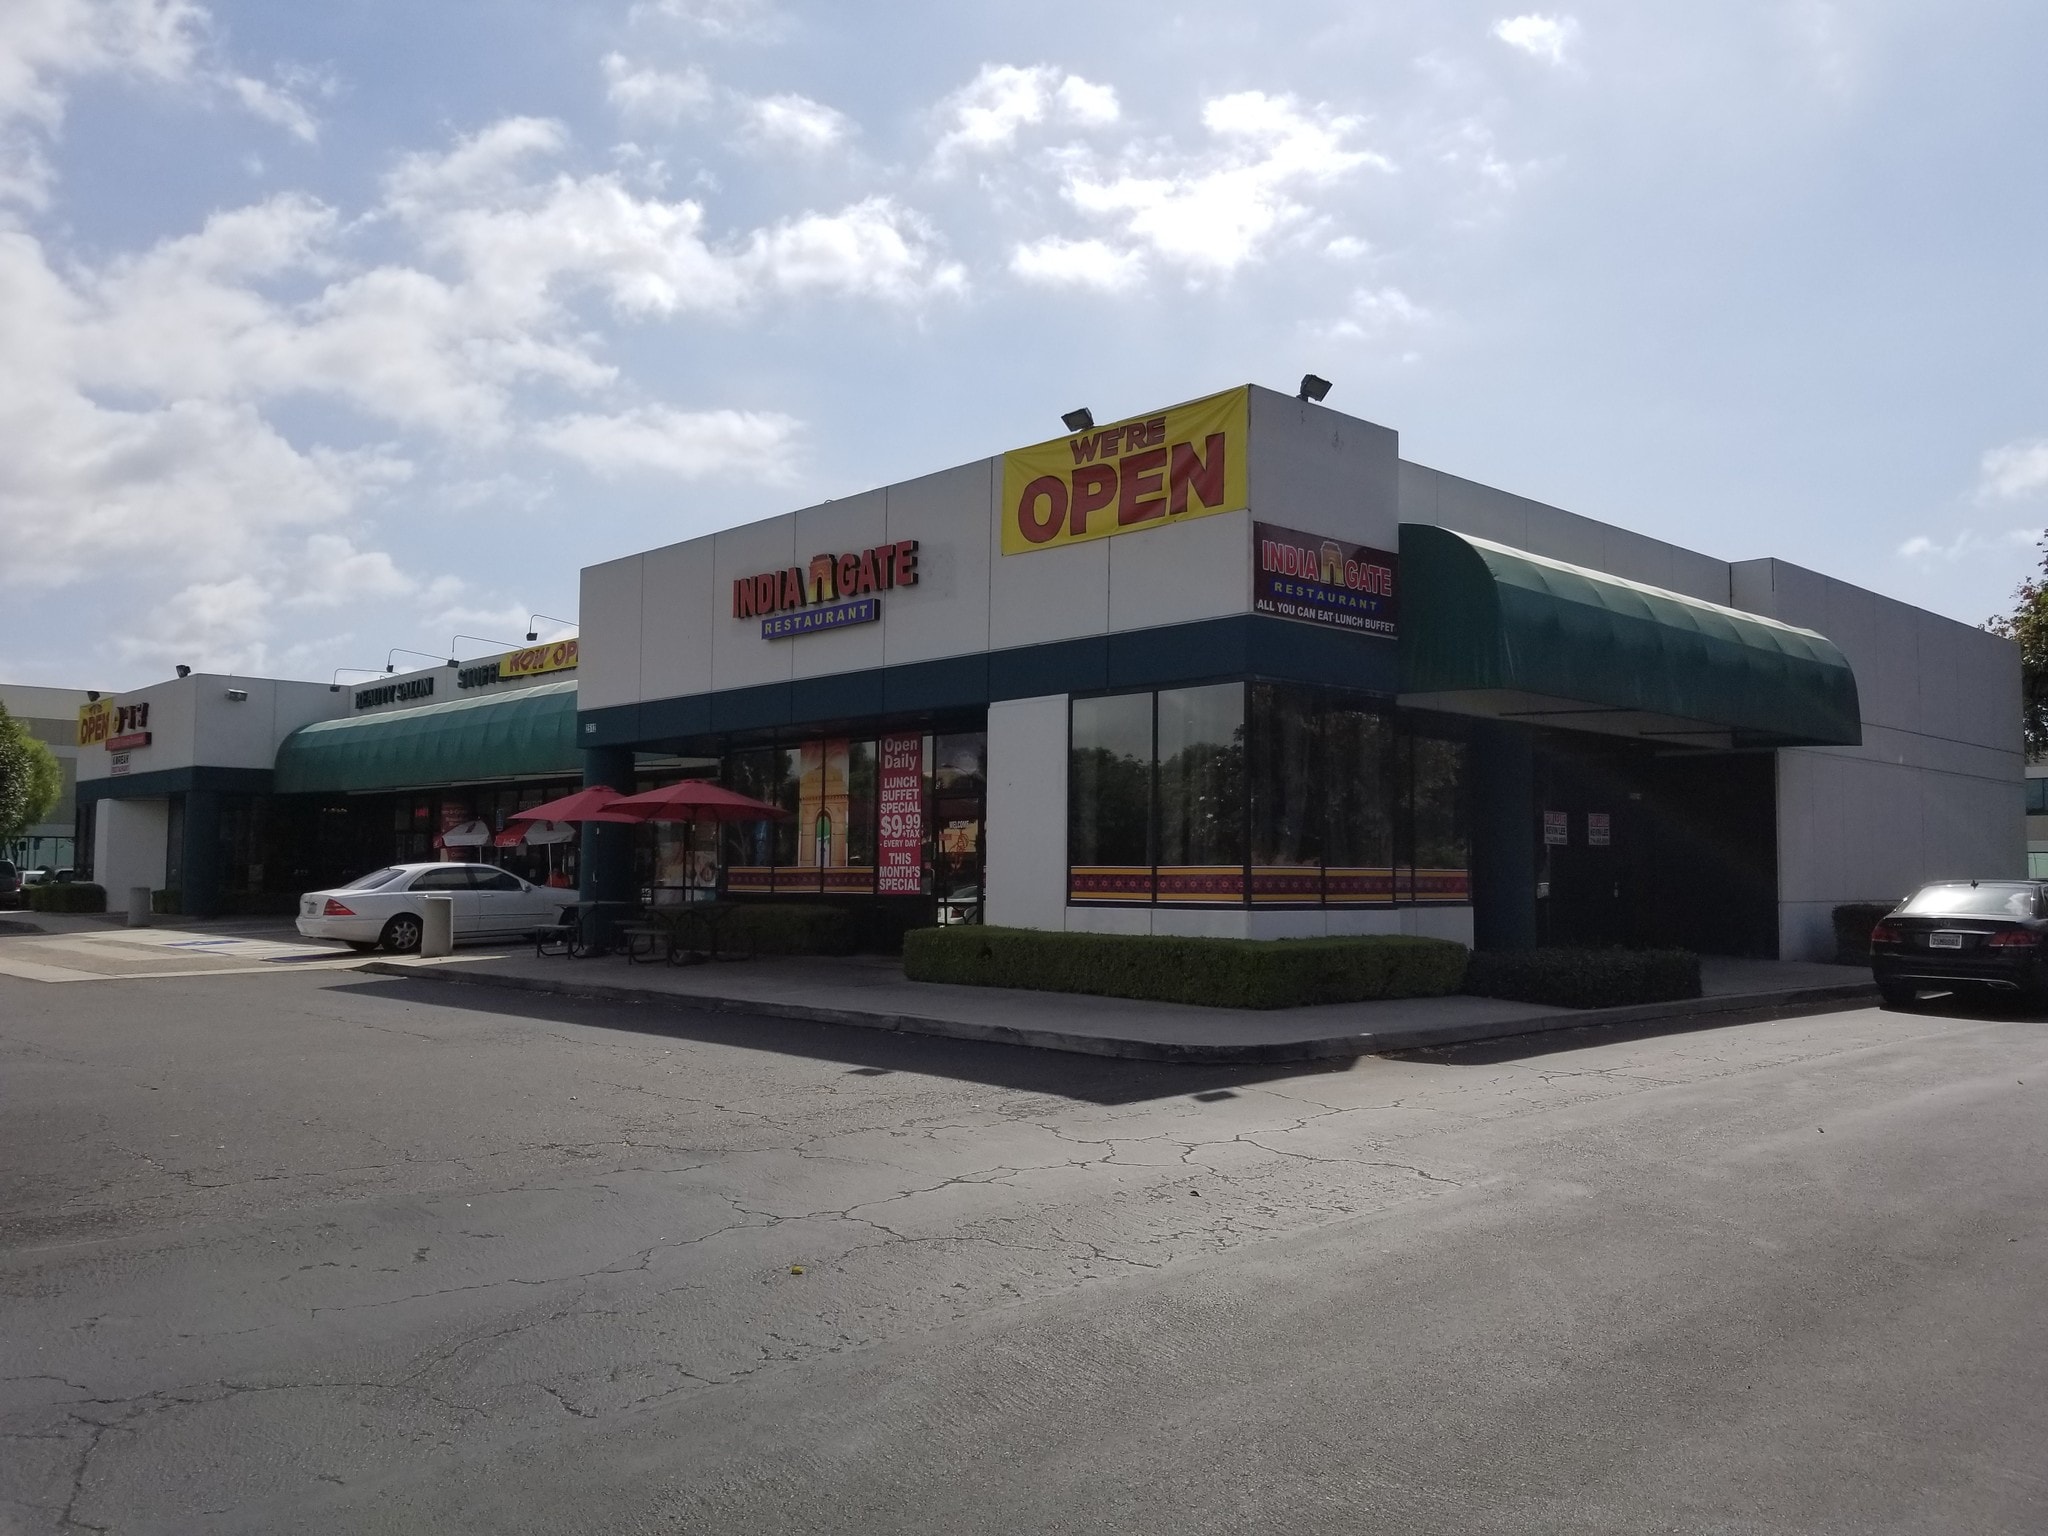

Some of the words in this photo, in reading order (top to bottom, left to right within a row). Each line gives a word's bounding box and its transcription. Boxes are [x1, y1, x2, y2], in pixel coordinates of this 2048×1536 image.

[1070, 416, 1167, 465] WE'RE
[1018, 432, 1226, 544] OPEN
[733, 567, 803, 618] INDIA
[837, 540, 917, 596] GATE
[1262, 540, 1319, 582] INDIA
[1345, 559, 1392, 597] GATE
[1274, 581, 1377, 611] RESTAURANT
[764, 605, 868, 634] RESTAURANT
[1257, 599, 1275, 612] ALL
[1277, 602, 1295, 615] YOU
[1297, 606, 1316, 619] CAN
[1317, 610, 1334, 622] EAT
[1335, 613, 1364, 628] LUNCH
[1365, 618, 1395, 633] BUFFET
[509, 648, 549, 672] NOW
[553, 642, 578, 666] OP
[457, 661, 501, 689] STUFF
[355, 685, 397, 709] BEAUTY
[396, 677, 434, 701] SALON
[81, 712, 110, 745] OPEN
[885, 738, 918, 755] Open
[885, 754, 917, 771] Daily
[882, 789, 919, 802] BUFFET
[884, 776, 917, 789] LUNCH
[880, 801, 921, 814] SPECIAL
[880, 814, 921, 838] $9.99
[902, 830, 920, 838] +TAX
[883, 840, 903, 848] EVERY
[905, 840, 917, 848] DAY
[888, 852, 911, 865] THIS
[879, 866, 921, 878] MONTH'S
[879, 878, 921, 891] SPECIAL
